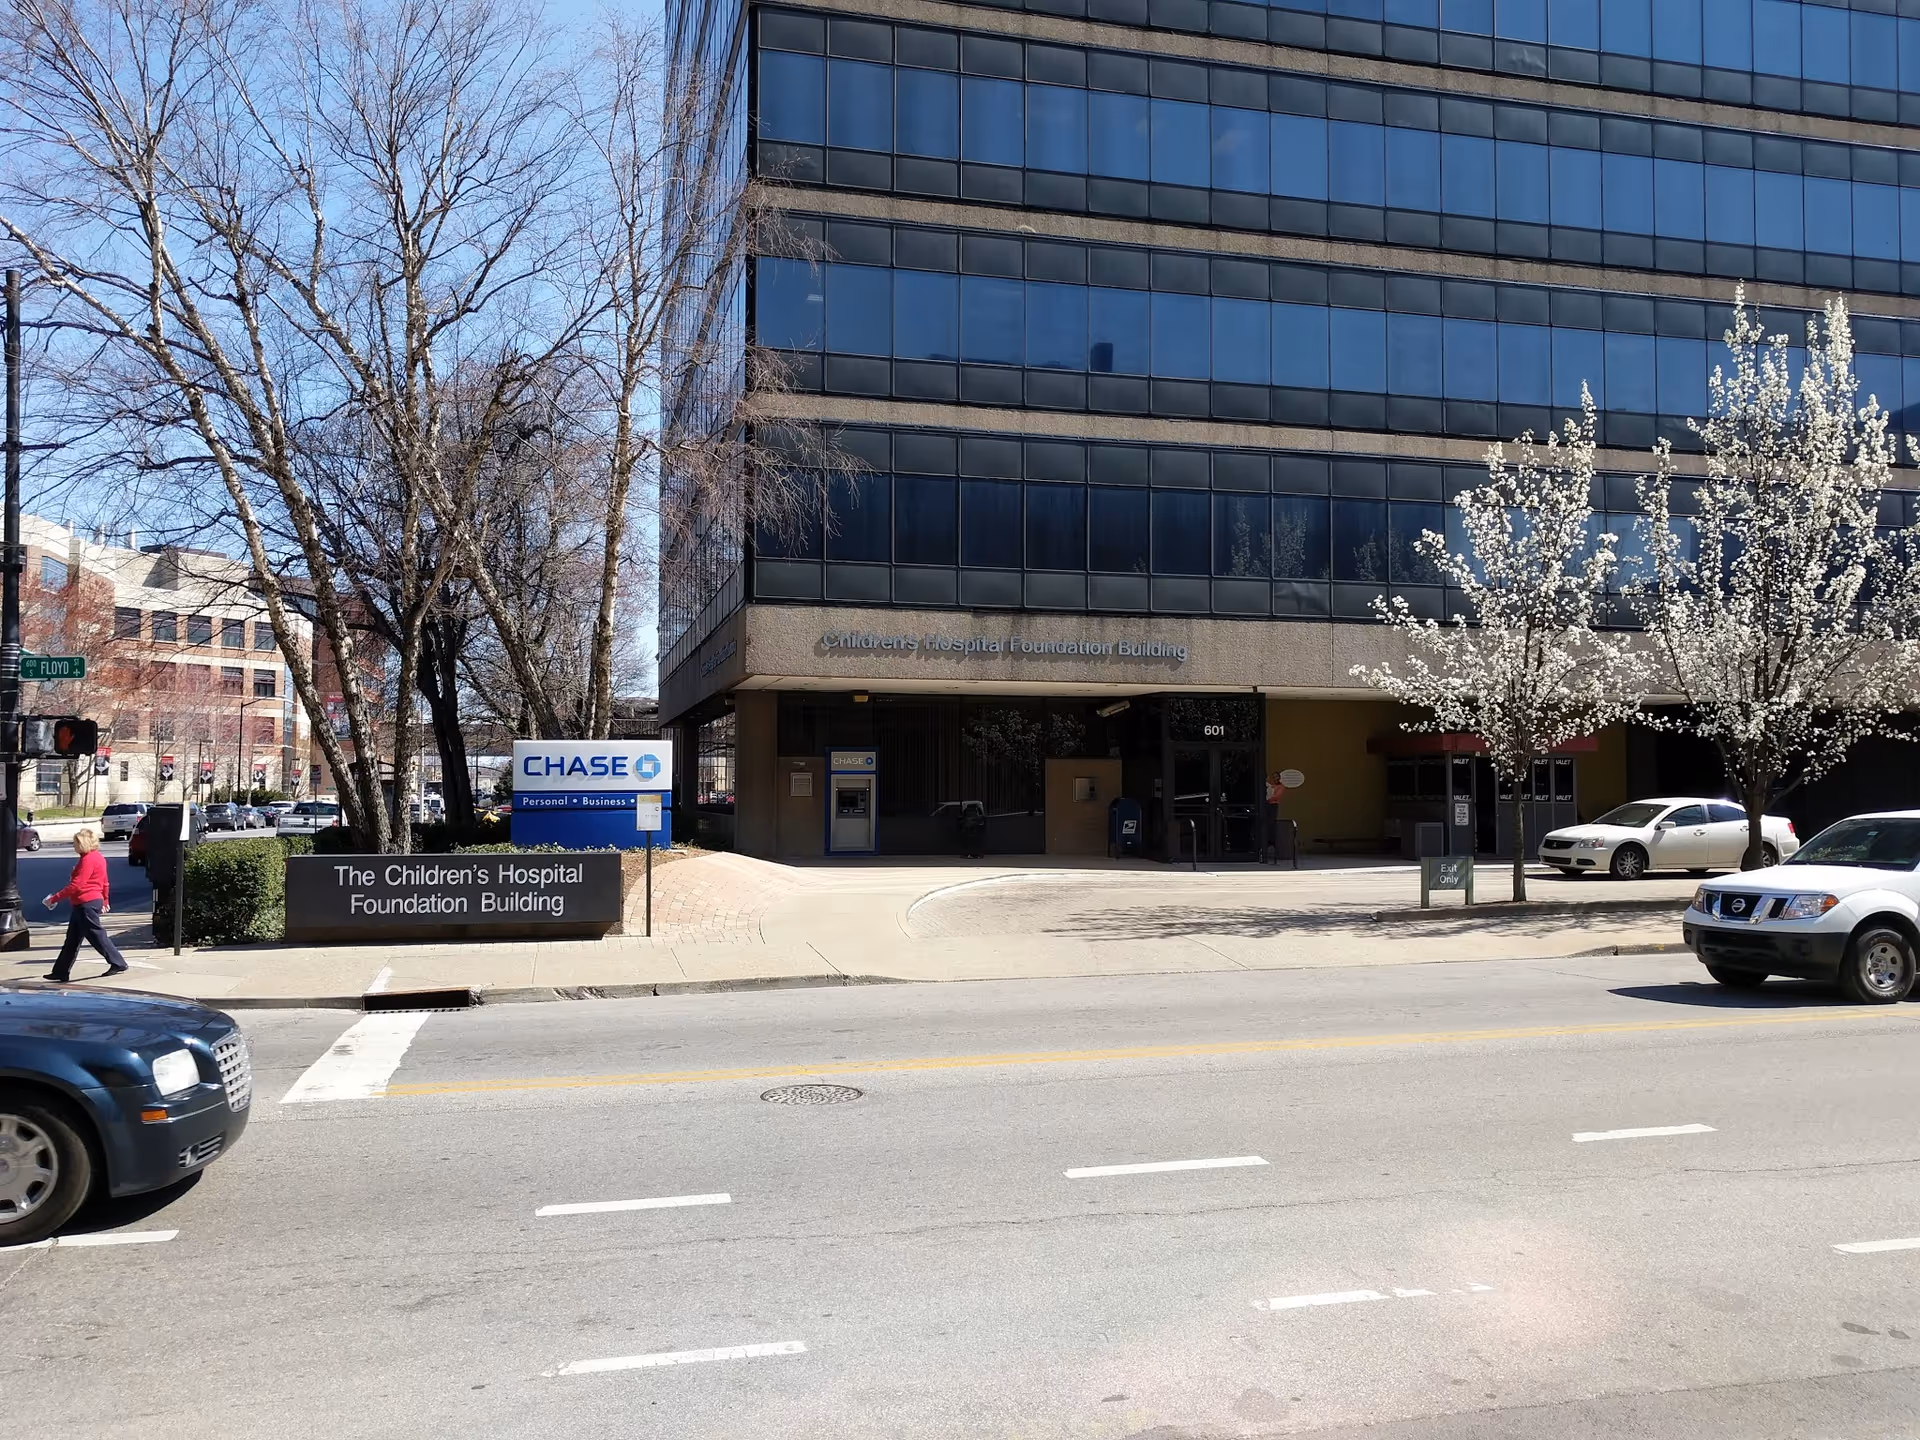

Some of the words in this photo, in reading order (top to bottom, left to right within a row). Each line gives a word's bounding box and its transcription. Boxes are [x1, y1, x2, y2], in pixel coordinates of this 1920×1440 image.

[924, 633, 1005, 656] Hospital
[1009, 635, 1113, 655] Foundation
[1118, 638, 1188, 662] Building
[26, 660, 37, 668] 600
[40, 661, 69, 675] FLOYD
[73, 658, 80, 666] ST
[29, 669, 34, 677] S
[1204, 725, 1225, 736] 601
[523, 756, 629, 776] CHASE
[833, 757, 864, 765] CHASE
[522, 796, 568, 806] Personal
[582, 796, 626, 806] Business
[1440, 864, 1458, 873] Exit
[333, 865, 376, 887] The
[384, 864, 490, 887] Children's
[498, 863, 583, 889] Hospital
[1439, 874, 1459, 885] Only
[350, 893, 468, 915] Foundation
[480, 891, 565, 917] Building
